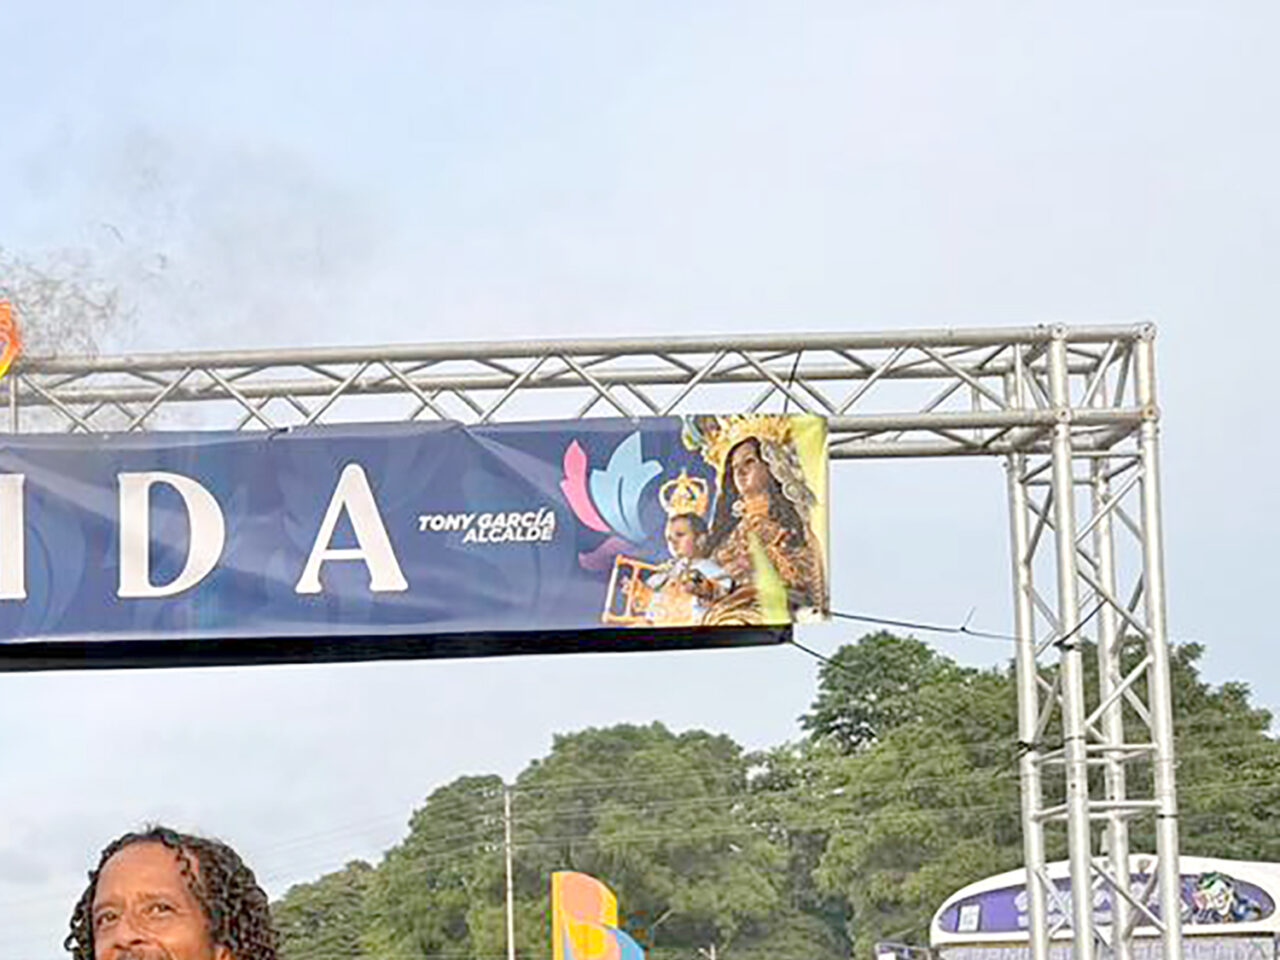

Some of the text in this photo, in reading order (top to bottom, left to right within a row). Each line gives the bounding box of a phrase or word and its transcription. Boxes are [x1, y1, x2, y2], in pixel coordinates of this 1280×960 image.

[418, 506, 556, 531] TONY GARCÍA
[461, 525, 553, 543] ALCALDE
